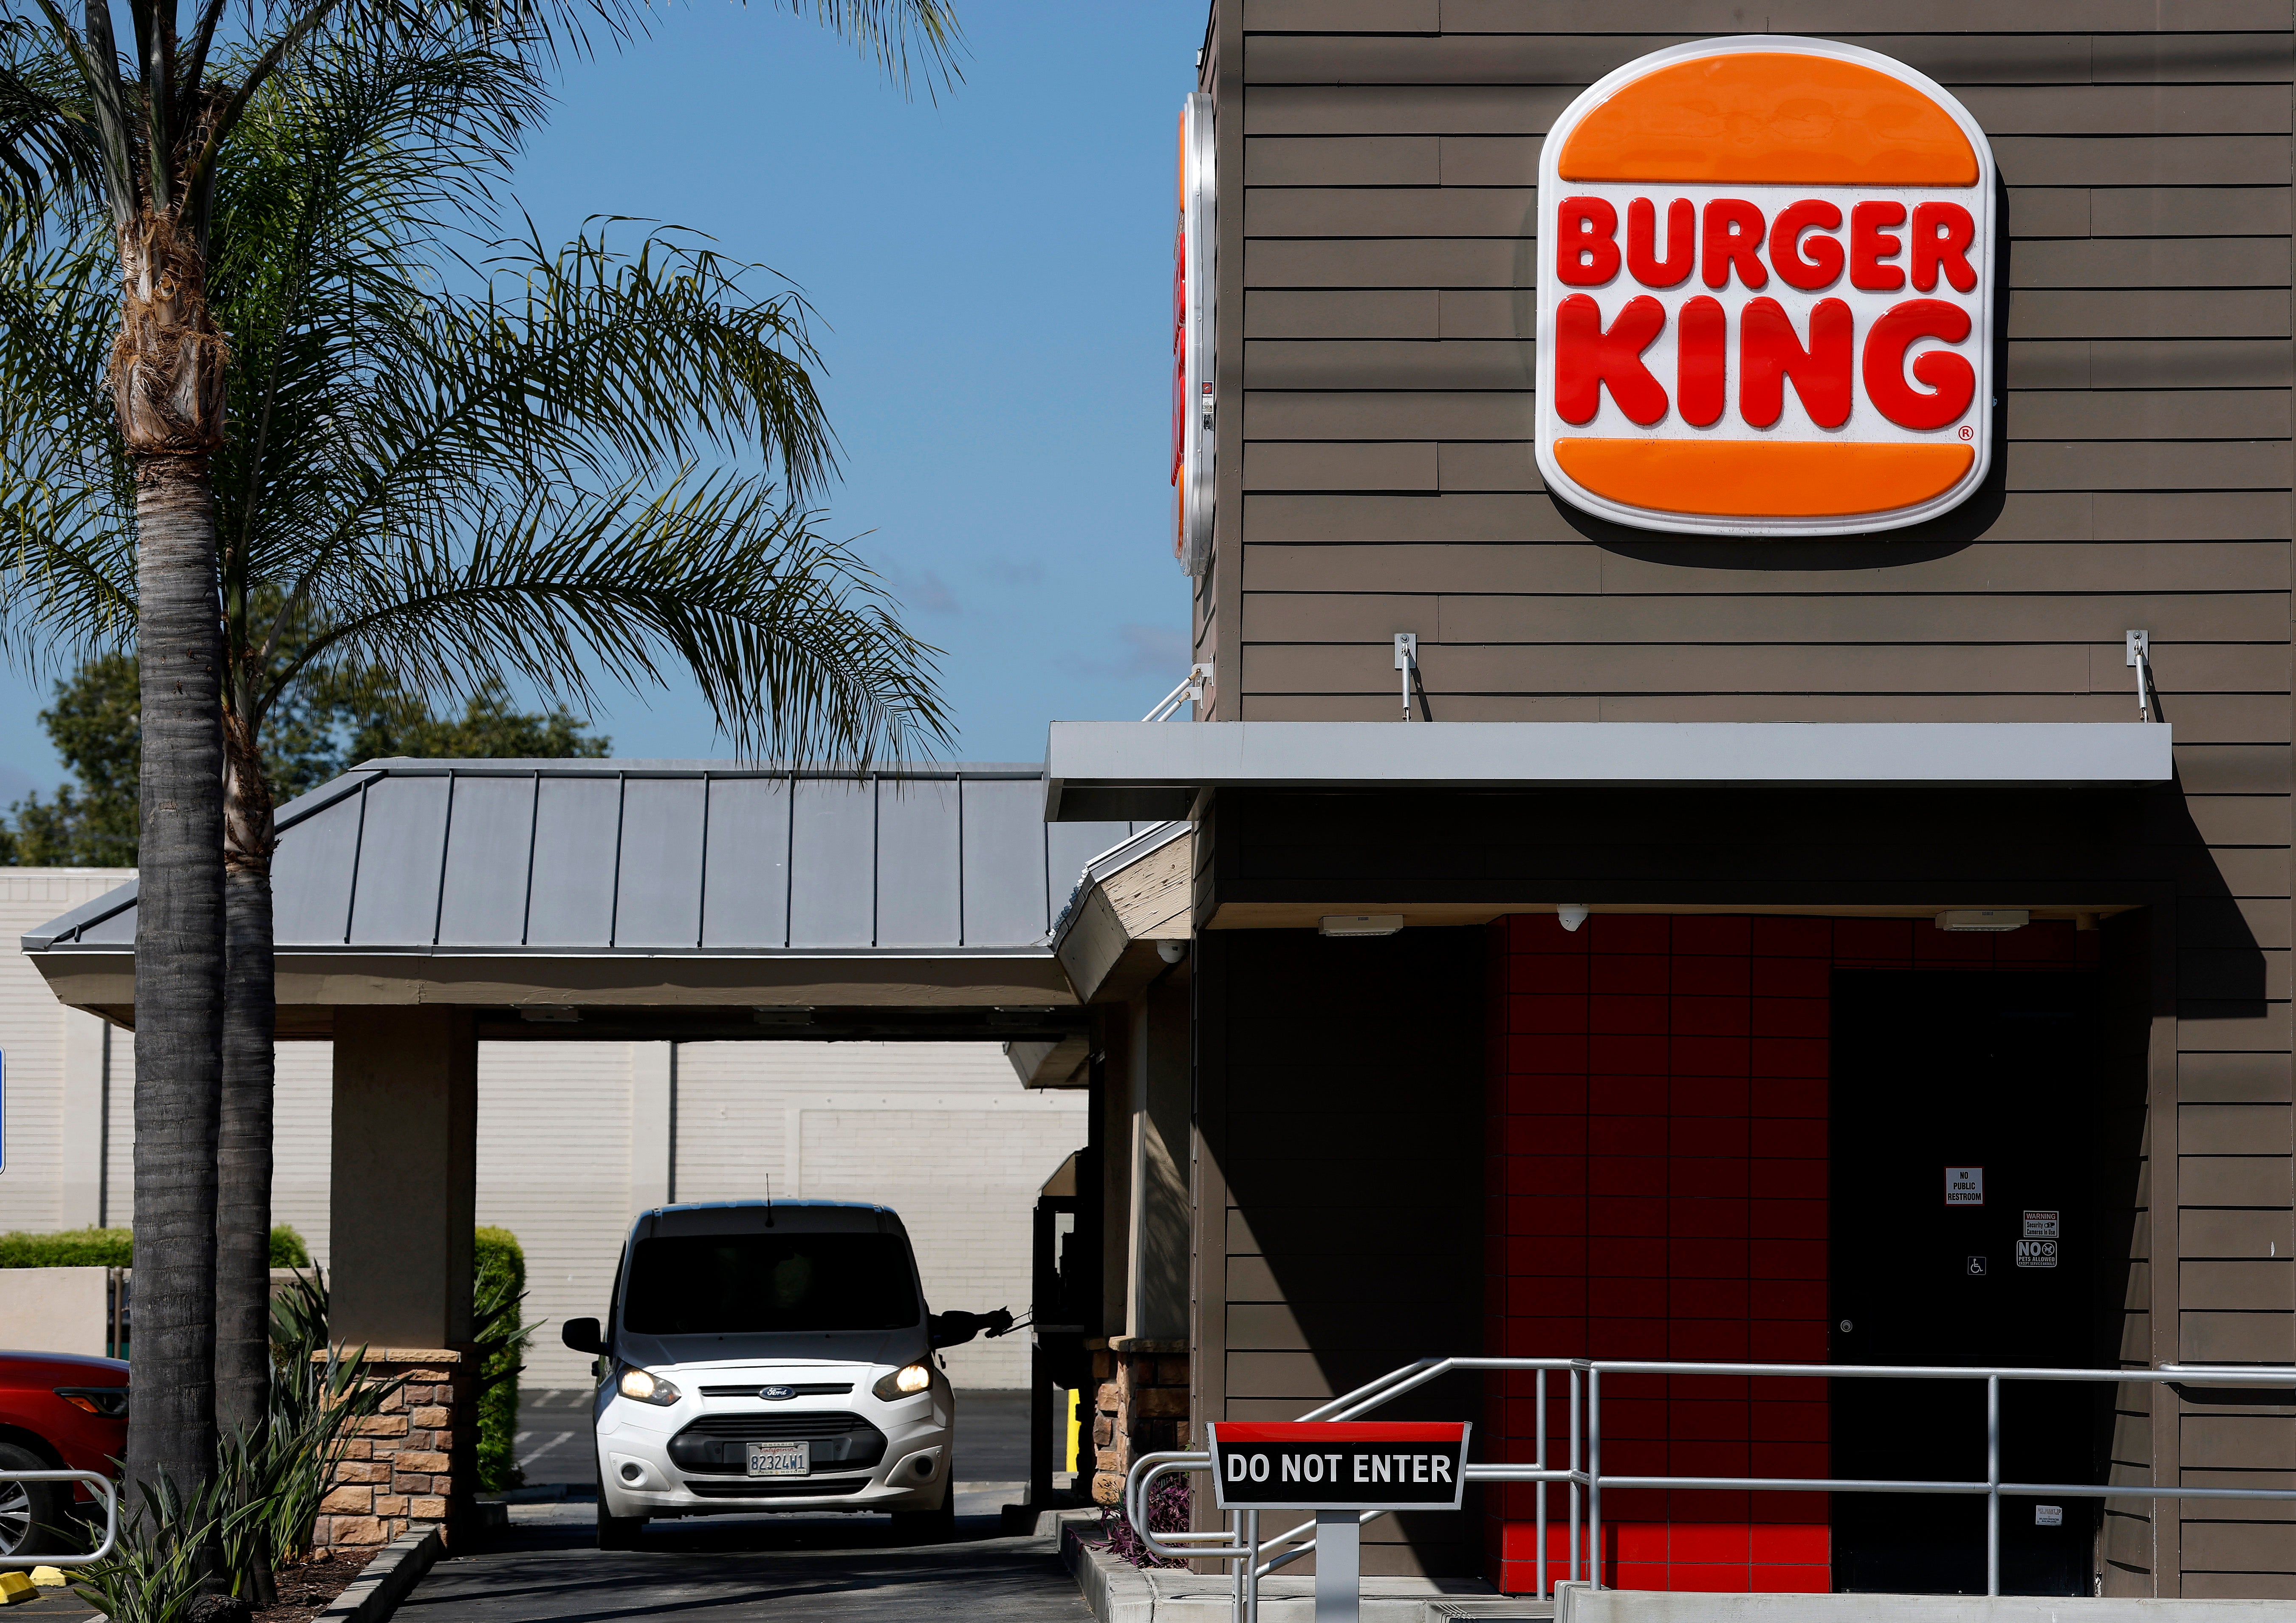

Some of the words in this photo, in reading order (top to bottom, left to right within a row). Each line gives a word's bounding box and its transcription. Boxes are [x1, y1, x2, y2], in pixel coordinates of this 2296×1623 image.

[1556, 196, 1977, 292] BURGER
[1554, 293, 1976, 430] KING
[1960, 1171, 1968, 1179] NO
[1948, 1193, 1982, 1201] RESTROOM
[2019, 1242, 2041, 1256] NO
[767, 1388, 787, 1396] Ford
[751, 1454, 804, 1470] 82324W1
[1228, 1453, 1270, 1482] DO
[1282, 1454, 1342, 1482] NOT
[1354, 1455, 1452, 1483] ENTER
